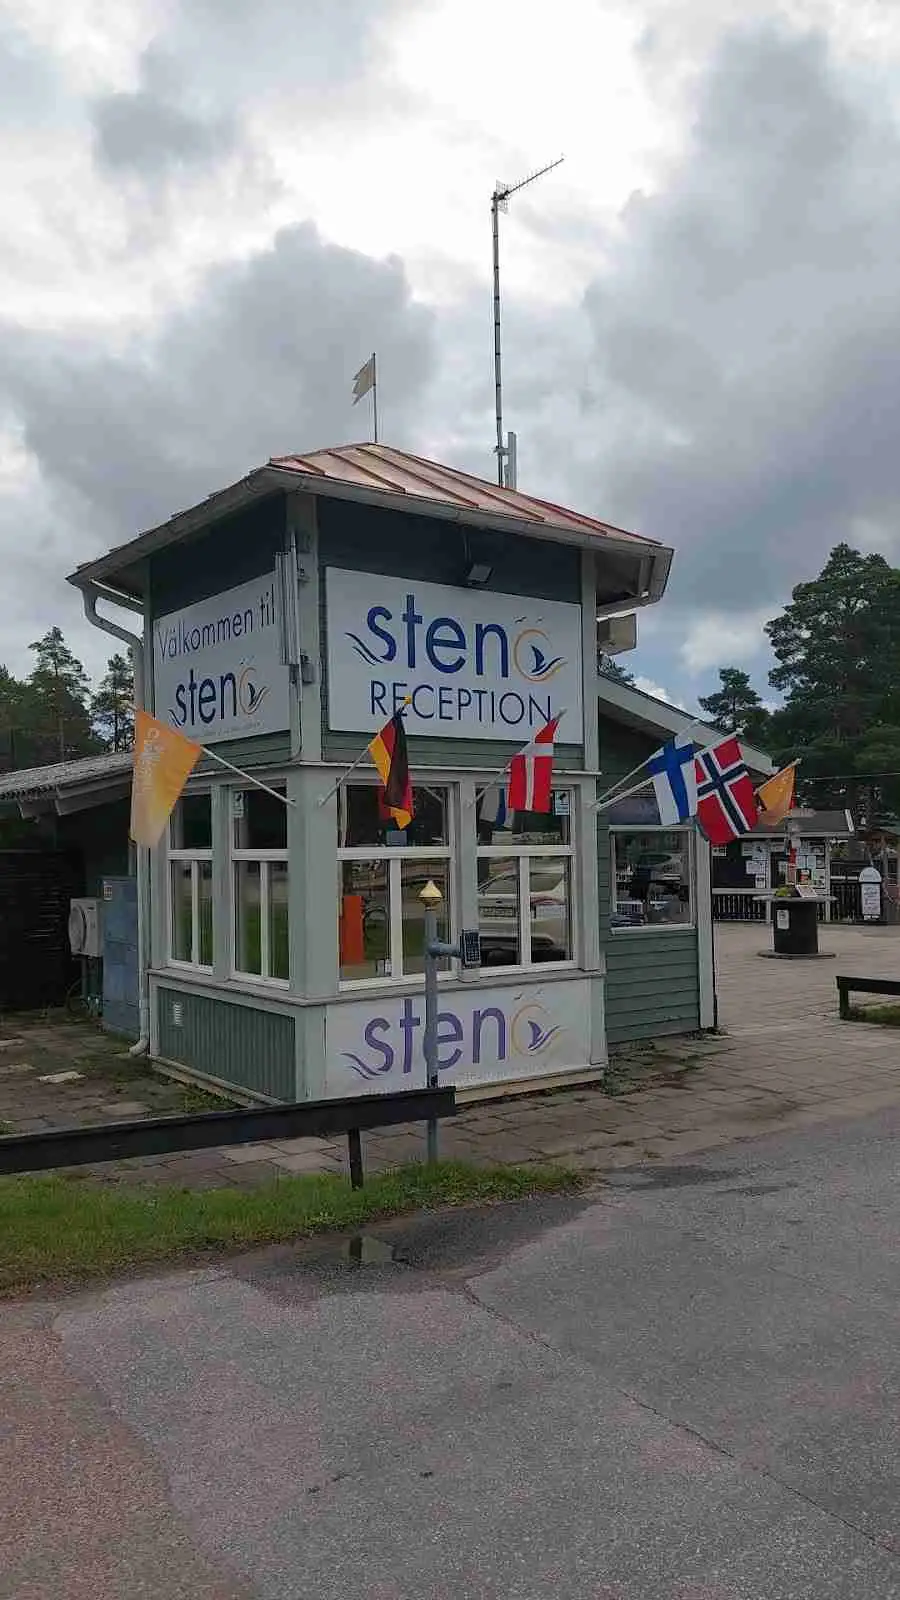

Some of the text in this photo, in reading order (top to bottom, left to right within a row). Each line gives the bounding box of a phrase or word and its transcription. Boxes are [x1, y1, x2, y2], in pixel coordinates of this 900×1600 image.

[159, 584, 275, 665] Välkommen til
[370, 680, 552, 725] RECEPTION
